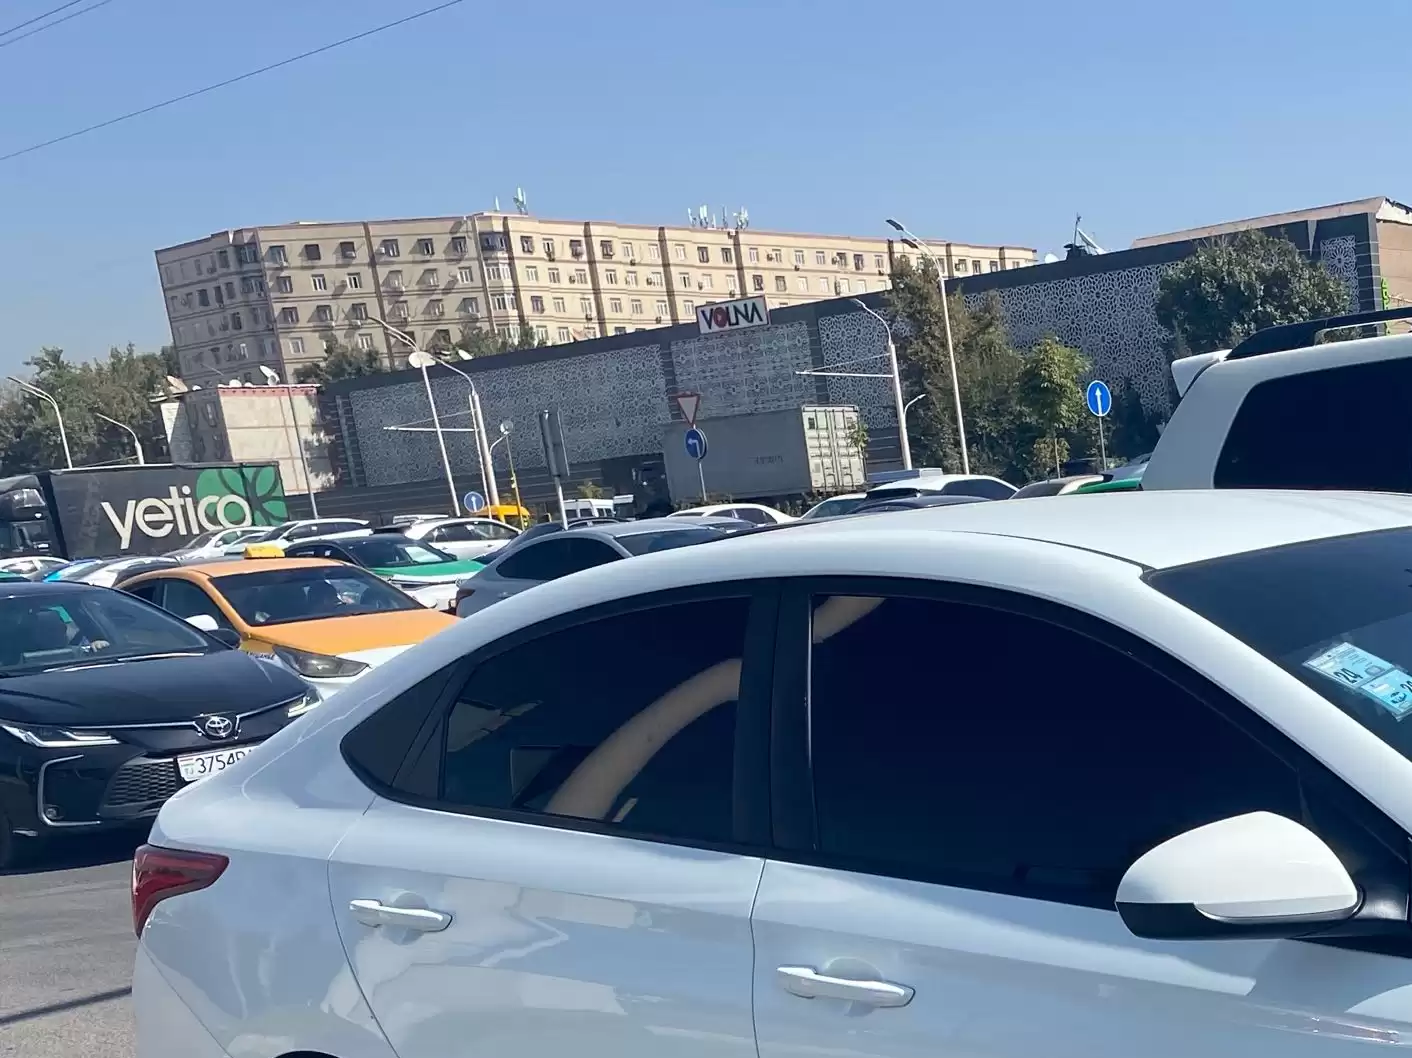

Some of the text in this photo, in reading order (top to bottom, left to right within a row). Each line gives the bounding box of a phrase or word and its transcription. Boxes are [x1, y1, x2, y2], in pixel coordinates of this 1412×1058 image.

[701, 302, 763, 329] VOLNA
[101, 485, 252, 550] yetico
[1333, 667, 1363, 684] 24
[195, 749, 252, 774] 3754
